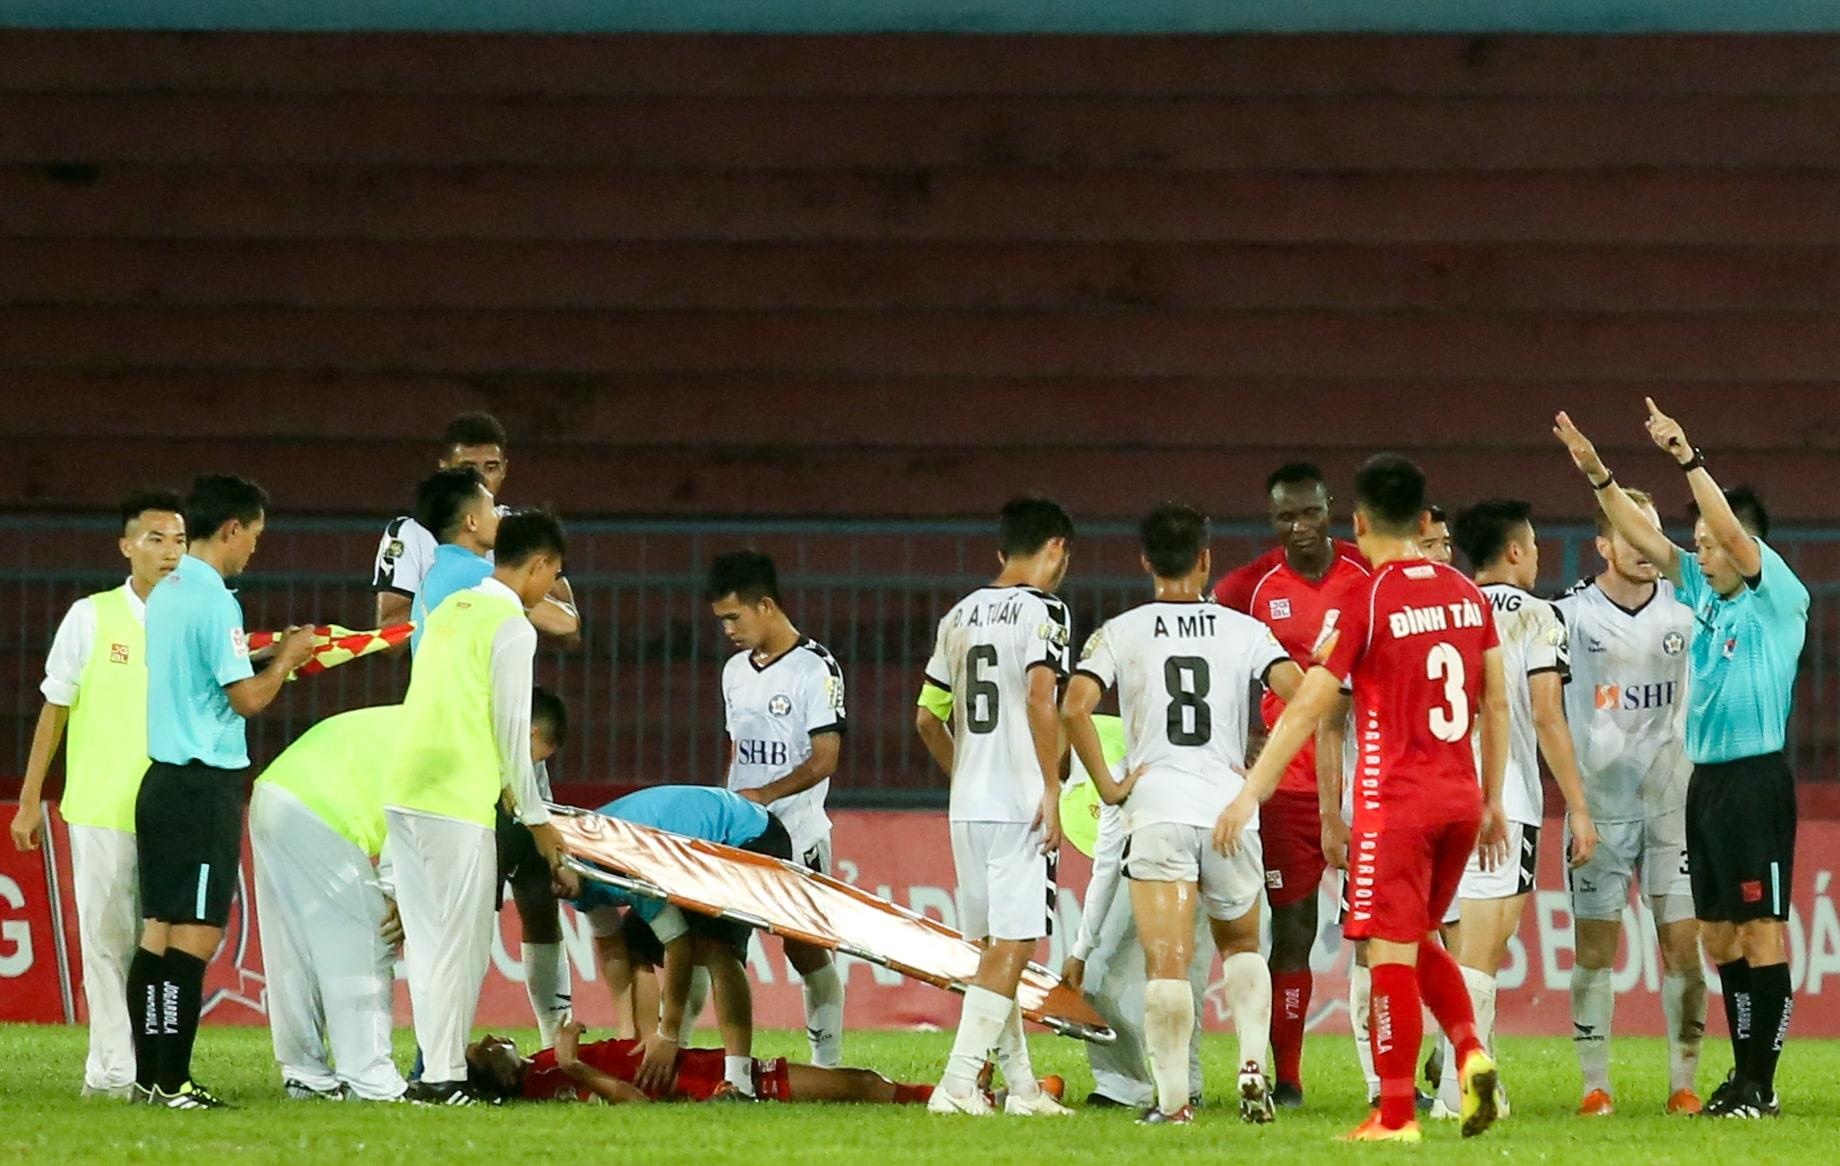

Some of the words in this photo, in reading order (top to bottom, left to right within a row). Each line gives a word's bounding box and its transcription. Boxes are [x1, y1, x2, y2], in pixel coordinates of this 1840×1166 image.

[1388, 605, 1447, 639] ĐÌNH
[1448, 597, 1484, 628] TÀI
[1488, 592, 1522, 612] NG
[1154, 615, 1169, 638] A
[1177, 609, 1216, 638] MÍT
[966, 644, 999, 734] 6
[1164, 655, 1212, 747] 8
[1426, 642, 1470, 743] 3
[738, 739, 787, 766] SHB
